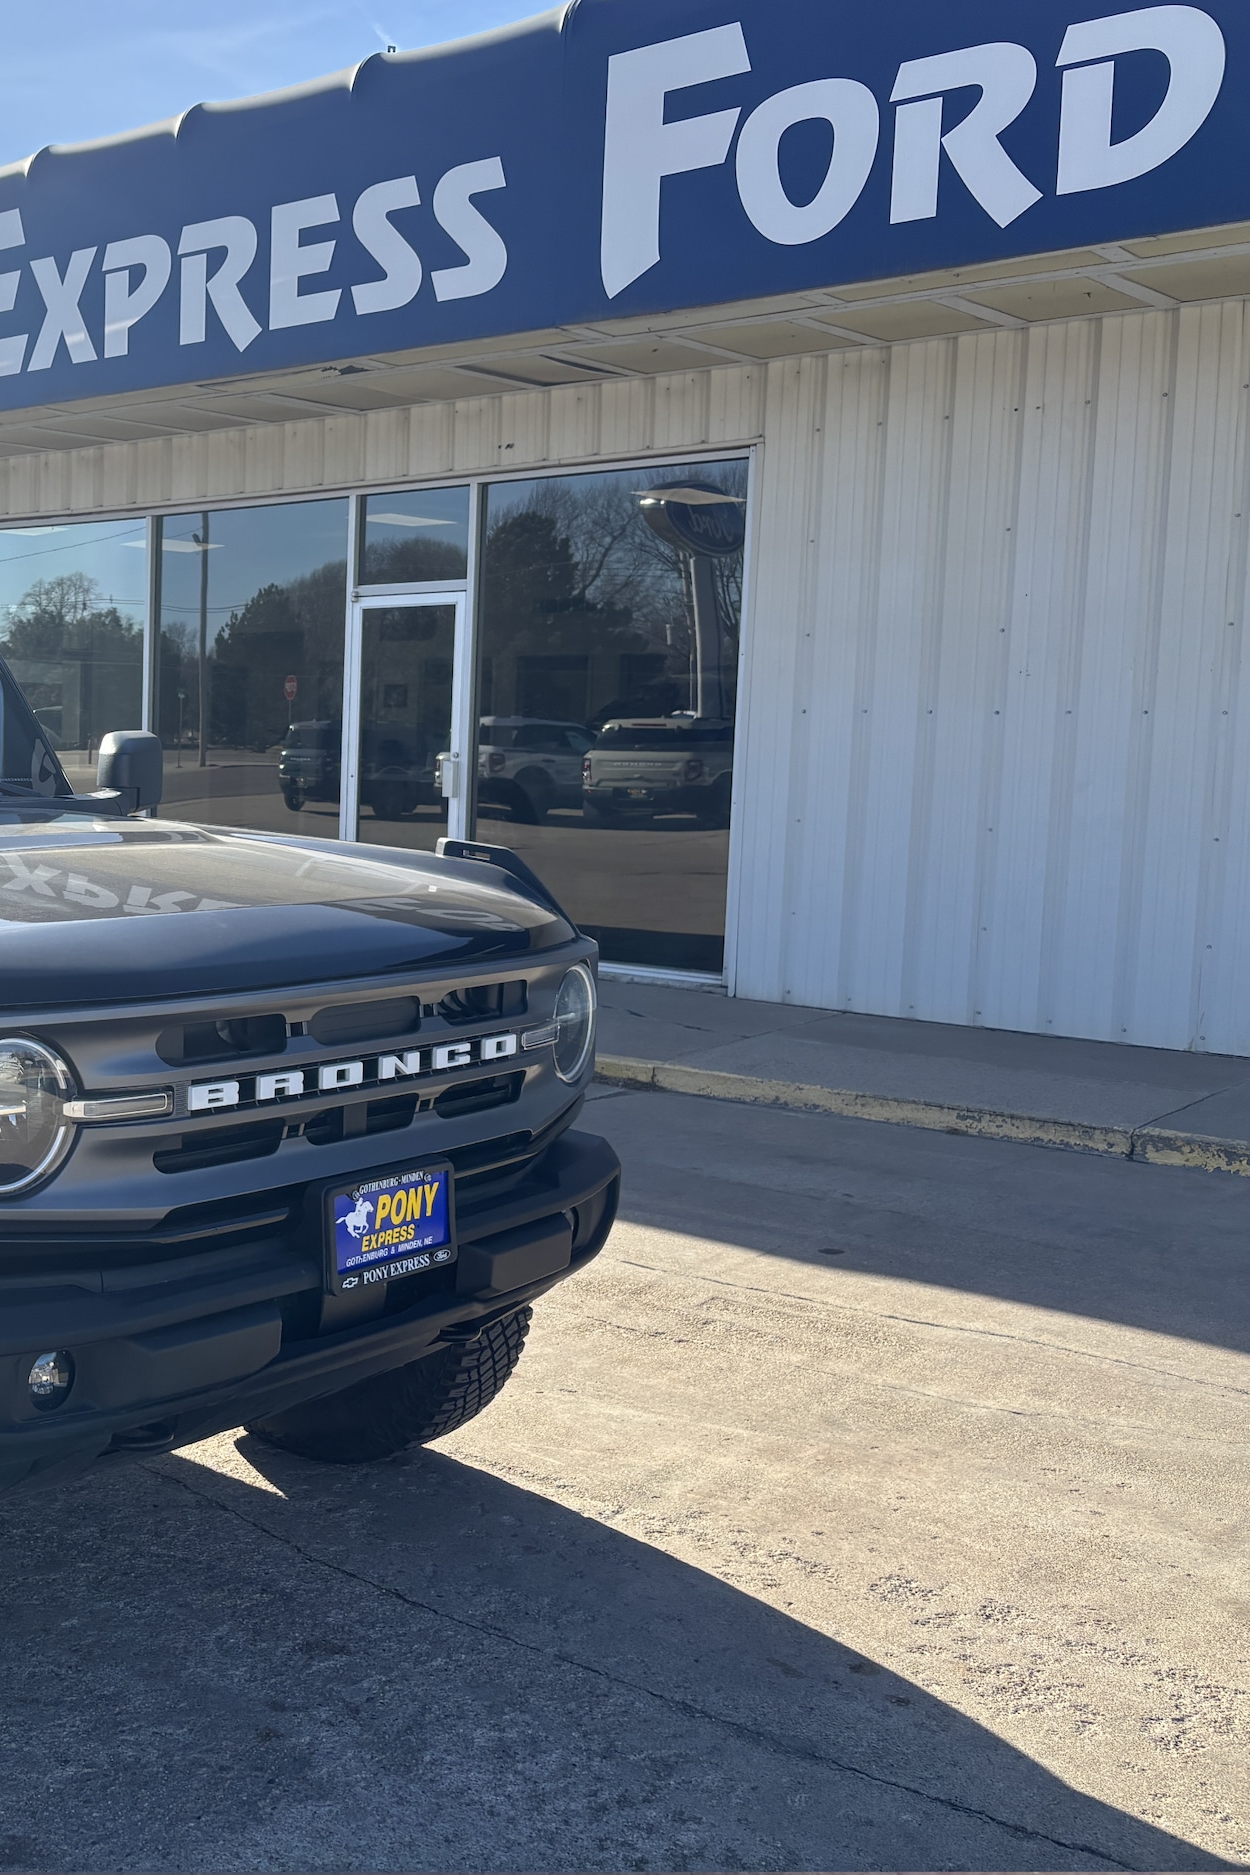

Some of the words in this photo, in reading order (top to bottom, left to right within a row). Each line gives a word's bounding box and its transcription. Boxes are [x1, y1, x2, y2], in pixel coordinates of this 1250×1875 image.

[599, 3, 1228, 301] FORD
[187, 1033, 517, 1111] BRONCO
[375, 1182, 439, 1230] PONY
[361, 1223, 416, 1252] EXPRESS
[423, 1235, 433, 1246] NE
[363, 1265, 390, 1285] PONY
[390, 1253, 431, 1277] EXPRESS
